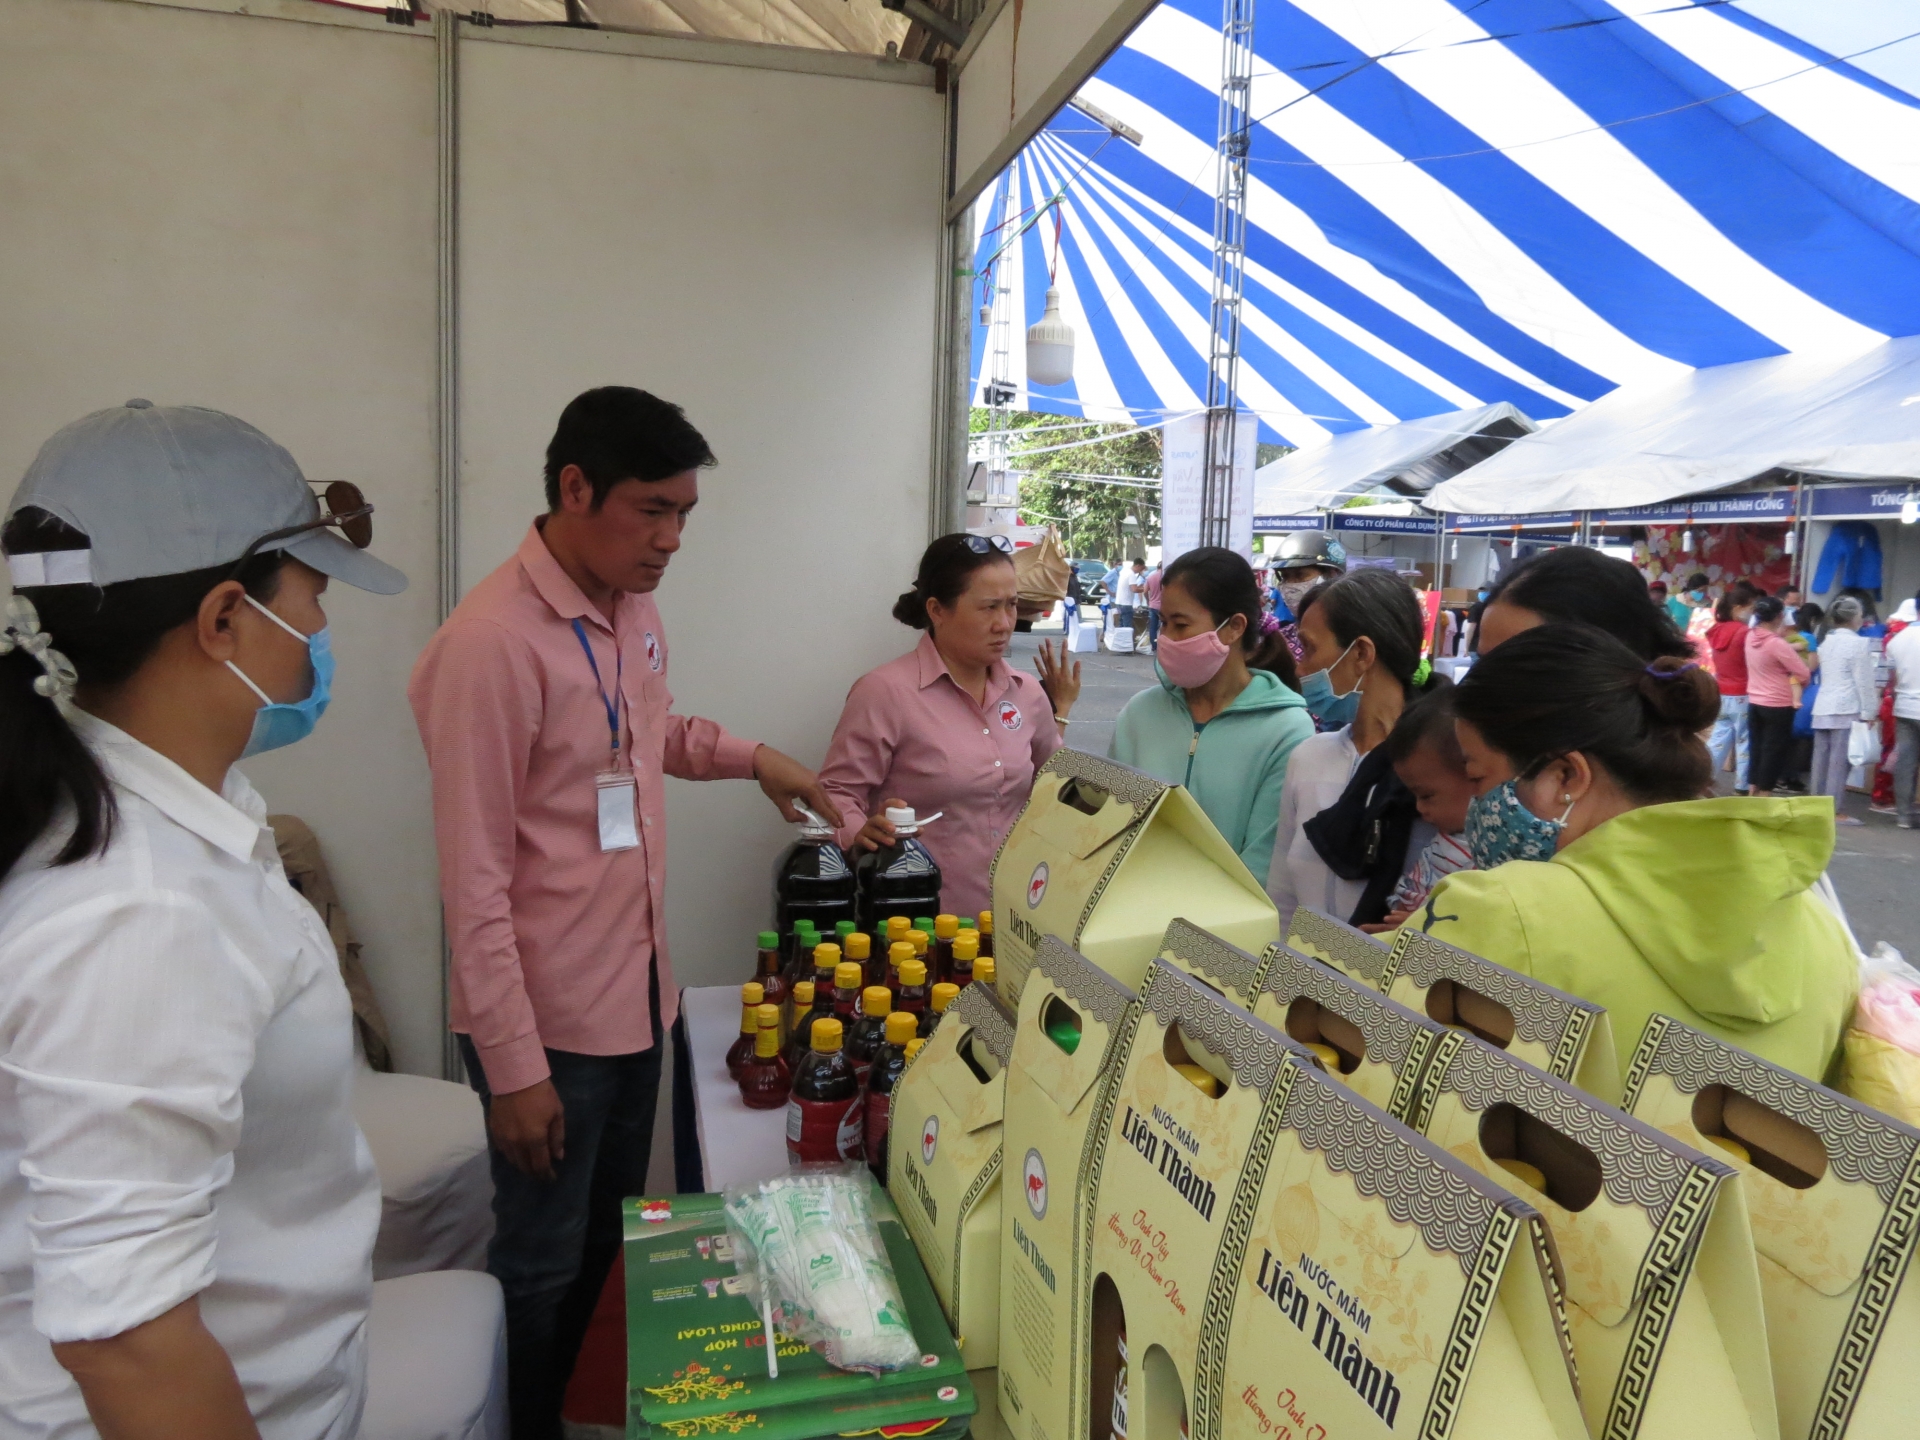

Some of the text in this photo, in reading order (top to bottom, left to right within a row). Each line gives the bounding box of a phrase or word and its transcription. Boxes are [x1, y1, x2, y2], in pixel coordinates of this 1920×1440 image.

[1344, 517, 1364, 527] CÔNG
[1365, 519, 1374, 527] TY
[1405, 521, 1417, 529] GIA
[1719, 498, 1753, 512] THÀNH
[1754, 497, 1785, 511] CÔNG
[1121, 1105, 1217, 1223] Liên Thành
[1151, 1104, 1200, 1157] NƯỚC MẮM
[905, 1151, 938, 1228] Liên Thành
[1013, 1216, 1029, 1257] Liên
[1029, 1239, 1057, 1295] Thành
[1298, 1252, 1372, 1334] NƯỚC MẮM
[1256, 1247, 1401, 1431] Liên Thành
